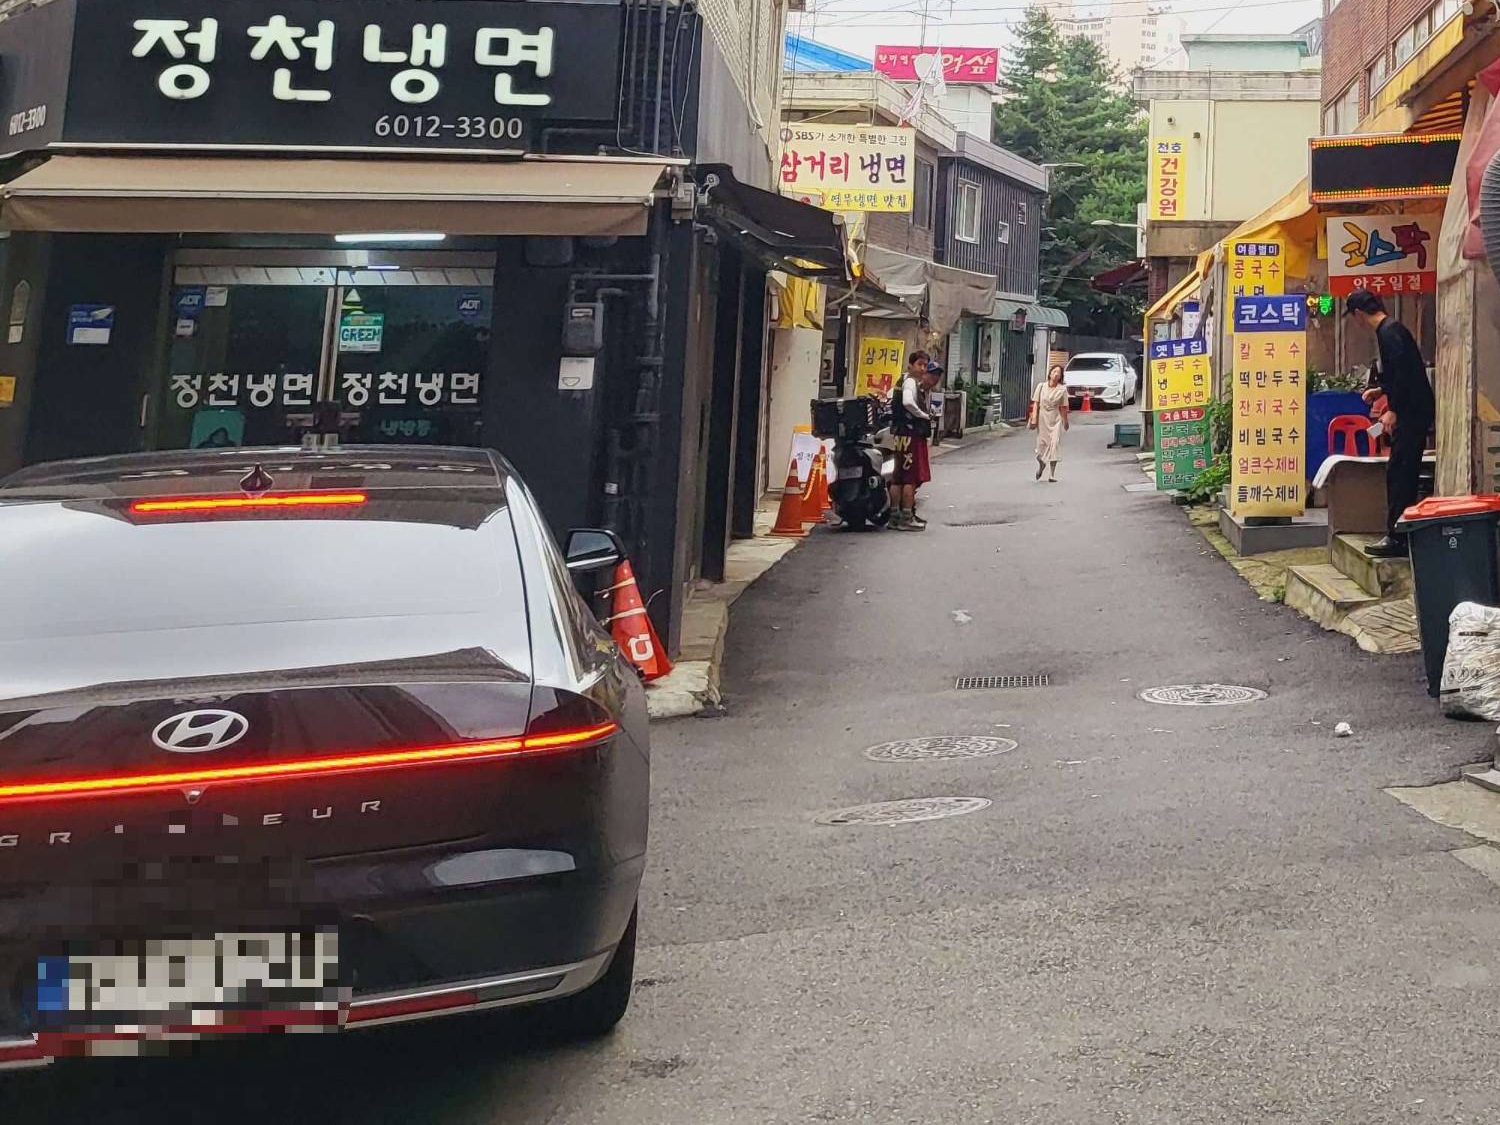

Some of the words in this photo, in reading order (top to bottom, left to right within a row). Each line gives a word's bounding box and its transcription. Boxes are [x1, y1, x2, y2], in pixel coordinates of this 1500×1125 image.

[131, 14, 554, 106] 정천냉면
[374, 114, 524, 140] 6012-3300
[795, 131, 825, 142] SBS가
[827, 132, 855, 144] 소개한
[858, 133, 888, 146] 특별한
[1157, 142, 1182, 154] 천호
[781, 150, 850, 183] 삼거리
[859, 152, 906, 184] 냉면
[1158, 157, 1179, 217] 건강원
[1237, 244, 1278, 256] 여름별미
[1341, 221, 1431, 270] 코스탁
[1233, 259, 1280, 280] 콩국수
[179, 295, 201, 305] ADT
[460, 300, 481, 310] ADT
[1239, 302, 1301, 325] 코스탁
[341, 328, 381, 342] GREEN
[866, 347, 900, 367] 삼거리
[1156, 340, 1203, 358] 옛날집
[1240, 342, 1301, 360] 칼국수
[1157, 358, 1203, 375] 콩국수
[1157, 375, 1204, 391] 냉면
[1239, 370, 1300, 389] 떡만두국
[170, 372, 313, 408] 정천냉면
[341, 372, 480, 407] 정천냉면
[1158, 391, 1204, 407] 열무냉면
[1239, 398, 1300, 418] 잔치국수
[1239, 427, 1299, 447] 비빔국수
[1238, 457, 1298, 475] 얼큰수제비
[1237, 485, 1298, 503] 들깨수제비
[0, 800, 381, 847] GREUR
